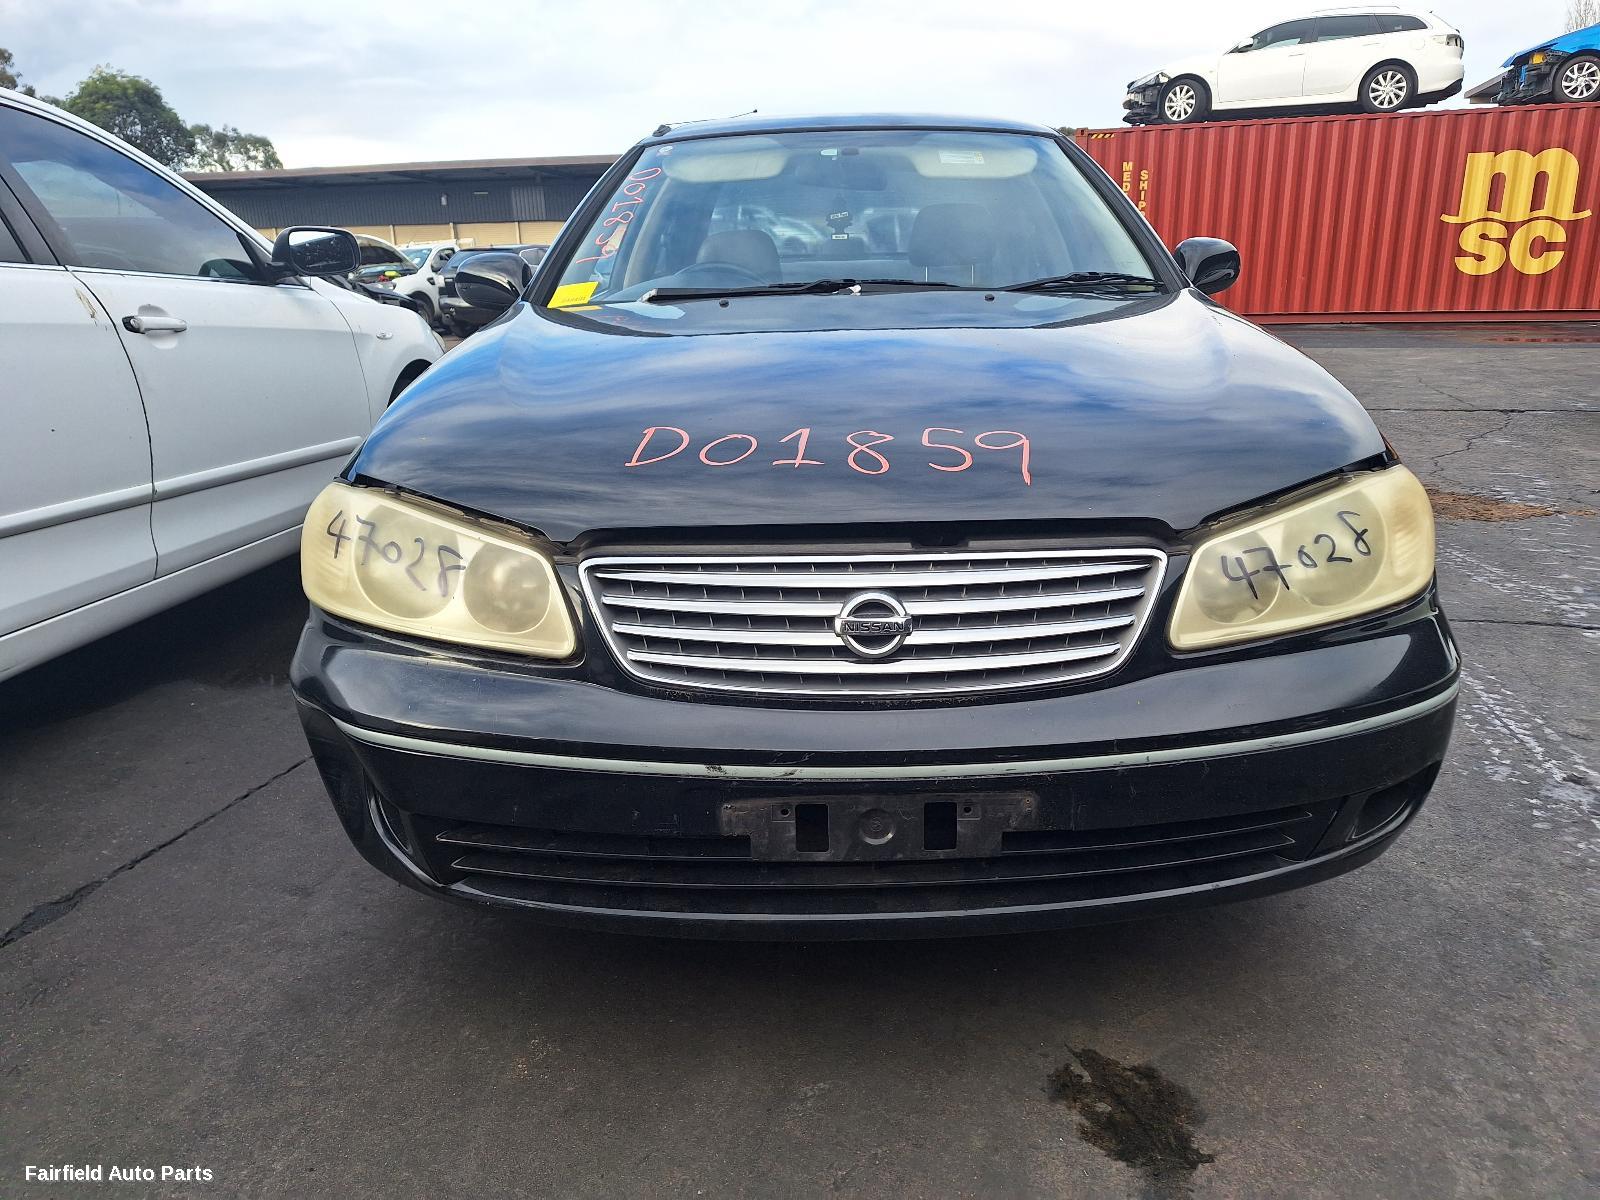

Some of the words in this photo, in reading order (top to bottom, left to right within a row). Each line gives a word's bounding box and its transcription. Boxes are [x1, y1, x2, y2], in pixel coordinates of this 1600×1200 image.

[1122, 161, 1133, 195] MED
[624, 426, 1031, 486] D01859
[844, 621, 905, 633] NISSAN
